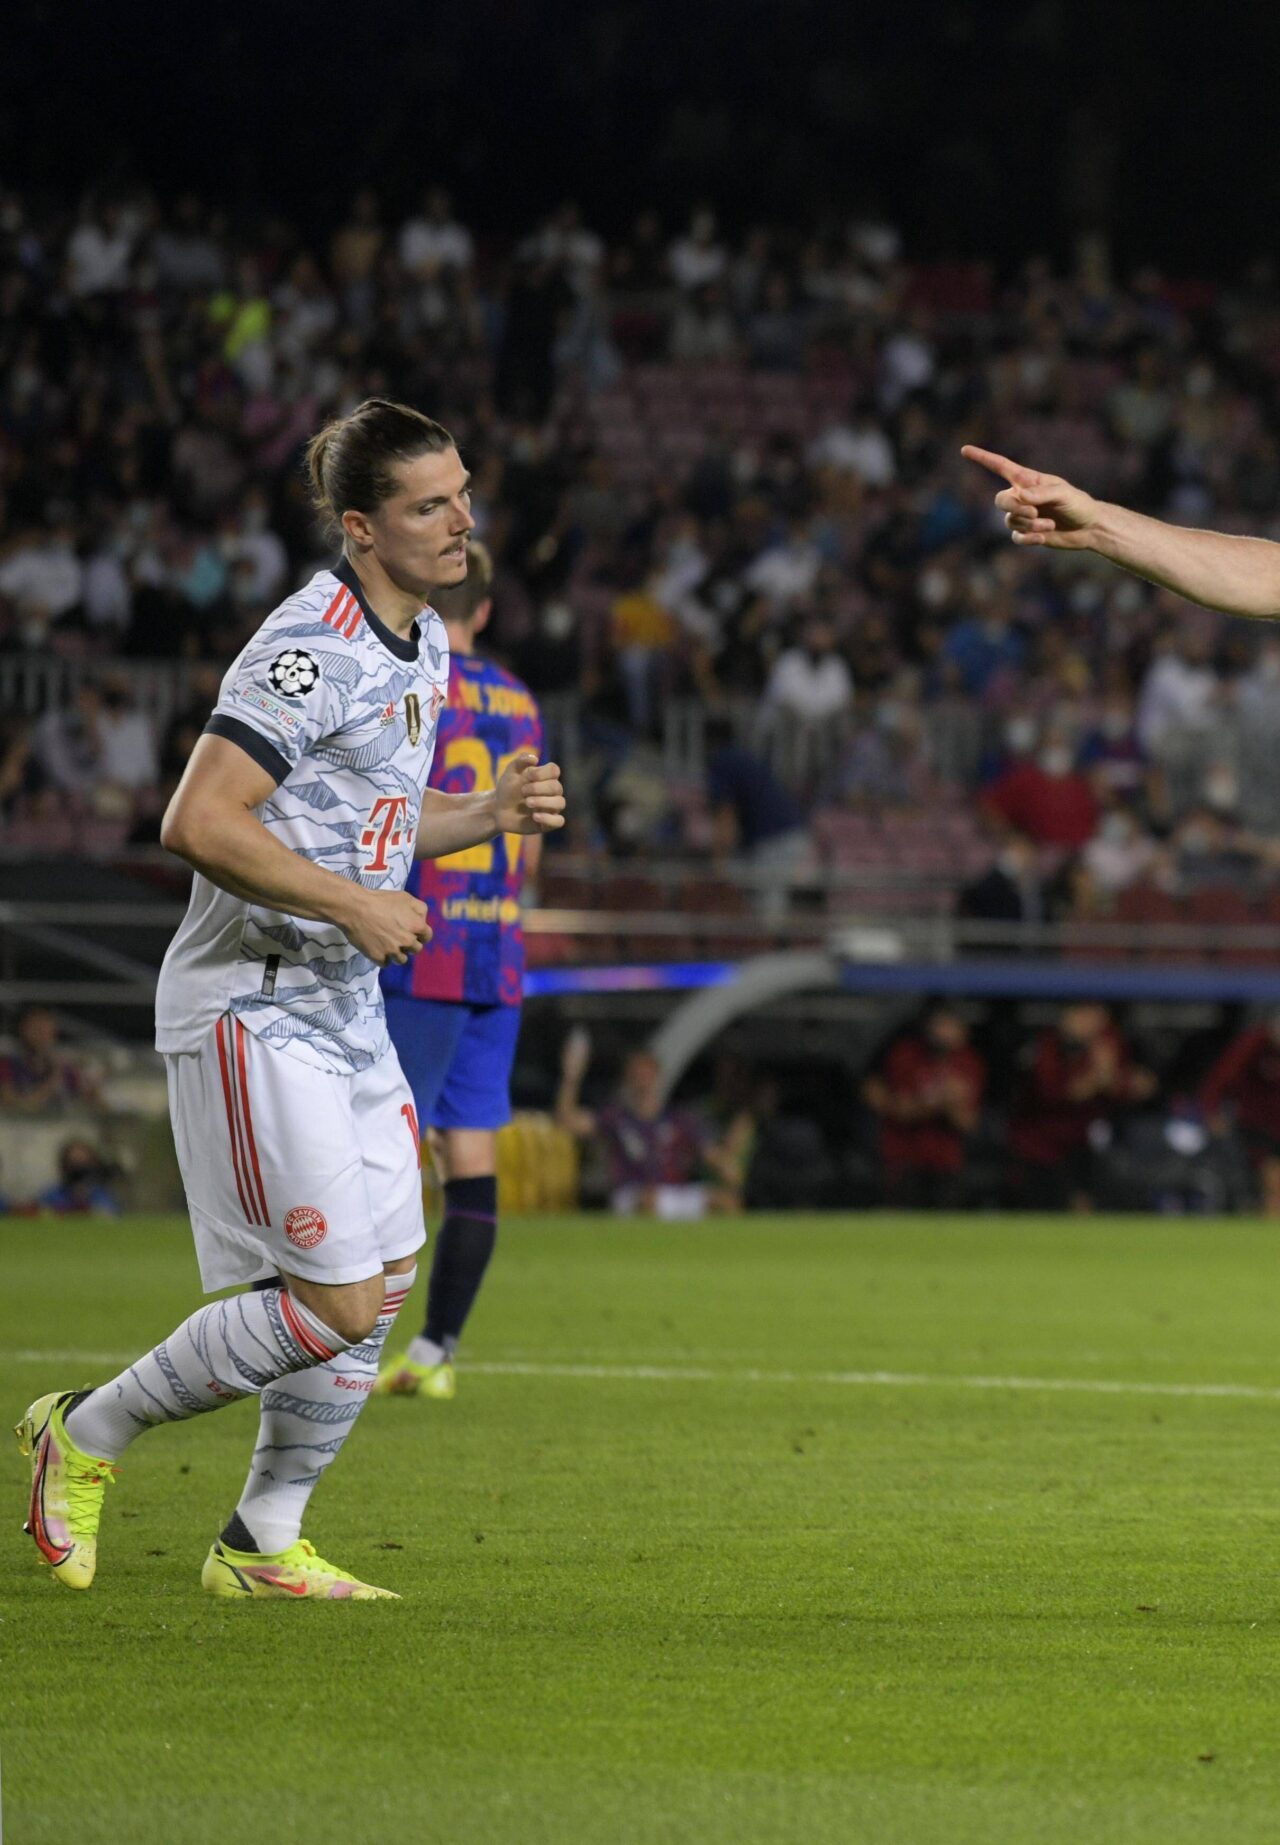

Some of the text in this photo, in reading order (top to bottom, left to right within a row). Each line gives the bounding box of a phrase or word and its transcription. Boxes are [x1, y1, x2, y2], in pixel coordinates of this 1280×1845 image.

[285, 662, 301, 682] 6
[242, 690, 302, 730] FOUNDATION
[364, 797, 407, 871] T
[292, 1210, 321, 1223] BAYERN
